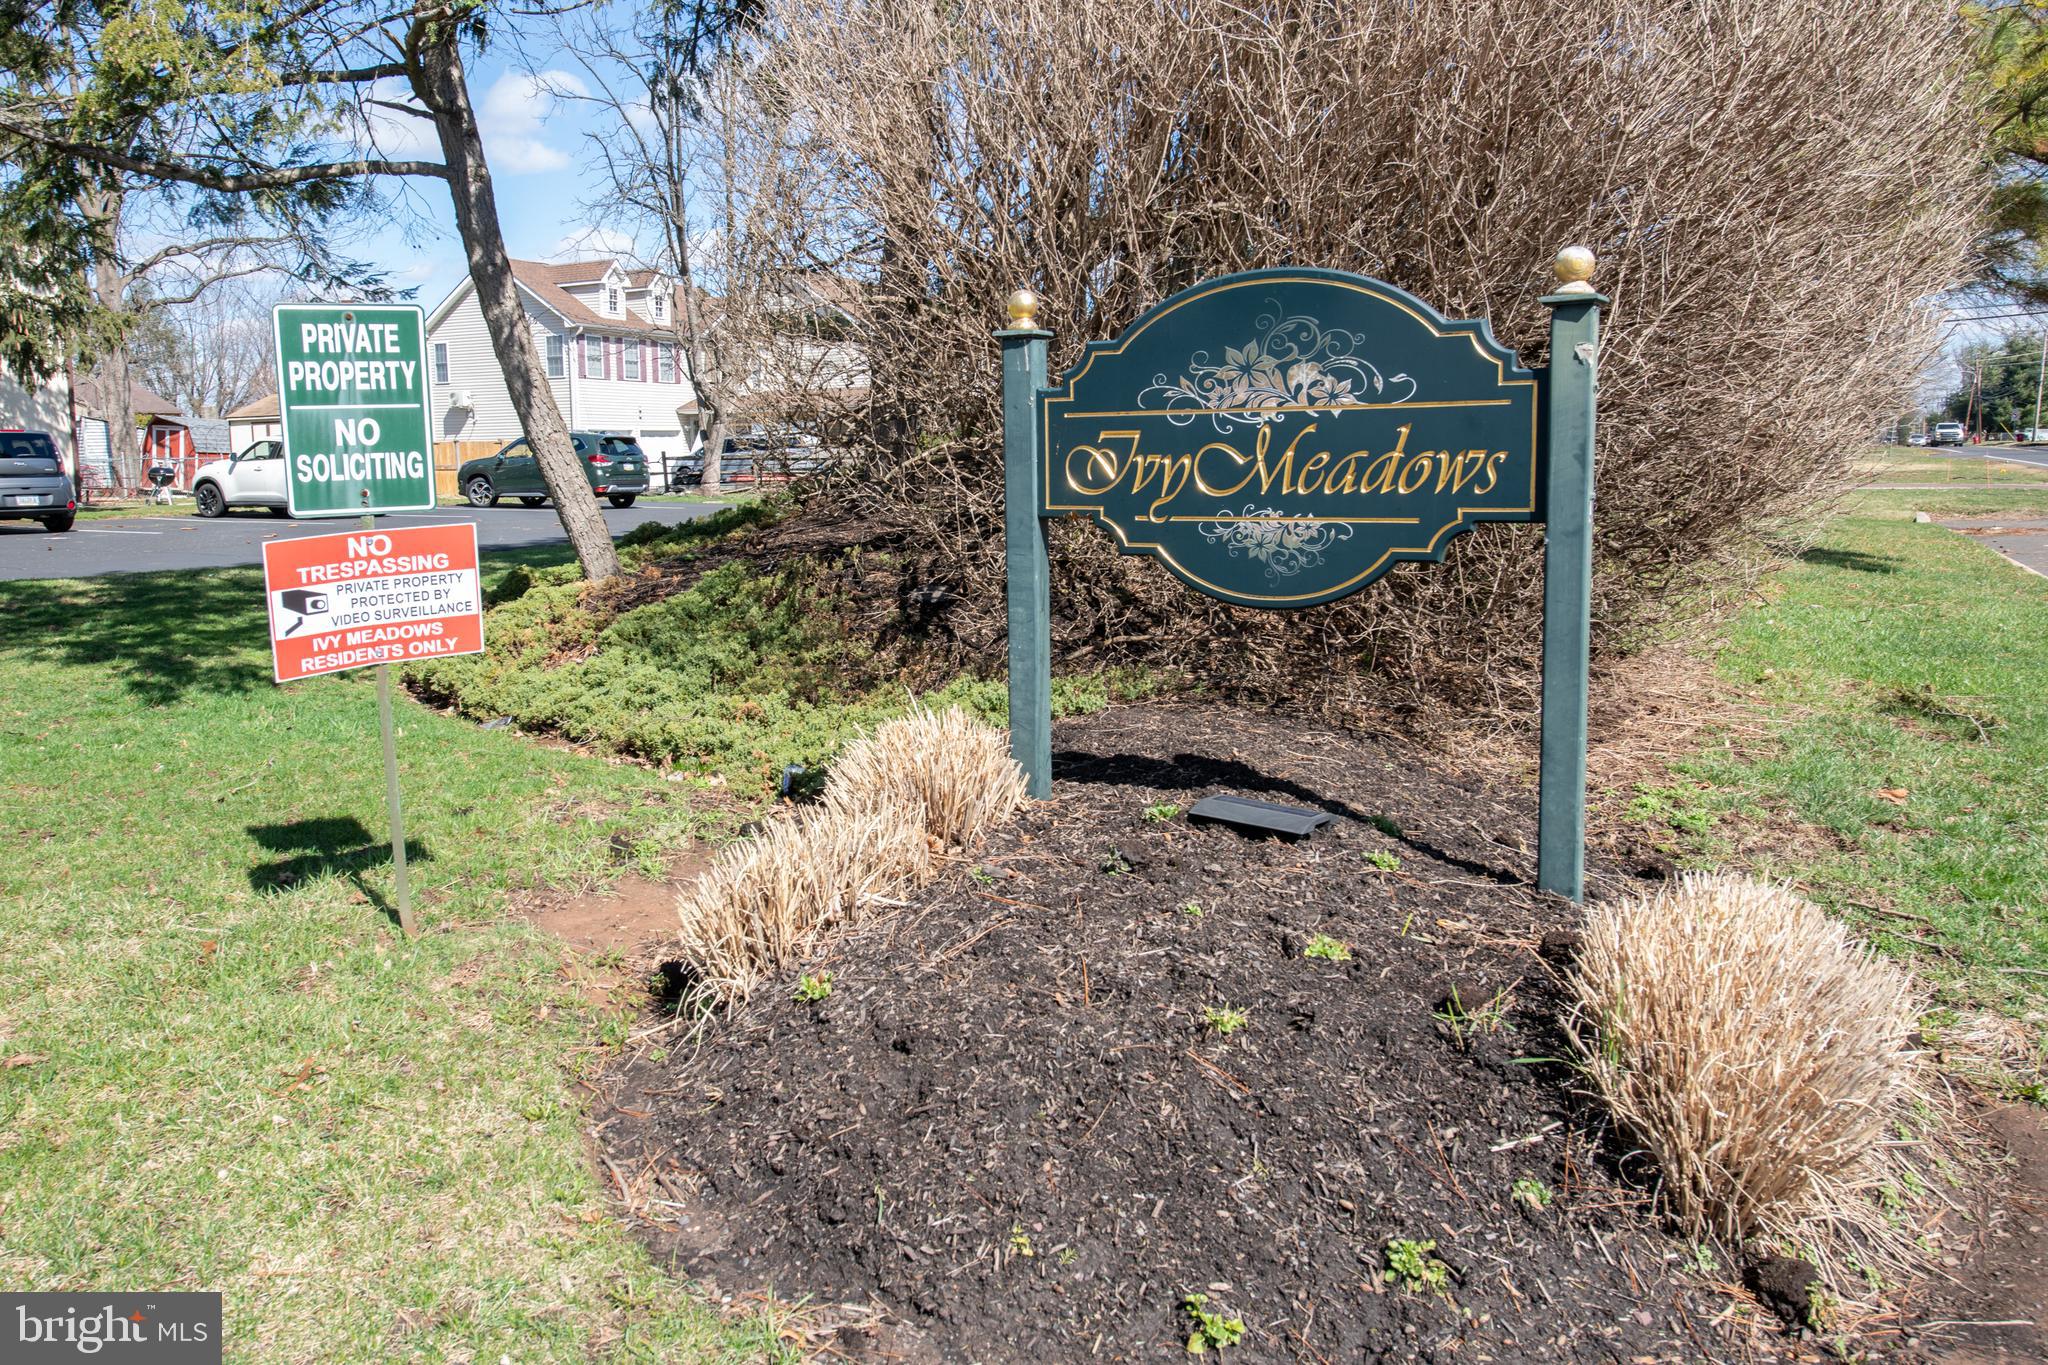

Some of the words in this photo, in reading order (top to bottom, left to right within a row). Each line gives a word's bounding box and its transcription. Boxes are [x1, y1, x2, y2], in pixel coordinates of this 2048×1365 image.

[301, 323, 400, 354] PRIVATE
[288, 360, 416, 391] PROPERTY
[334, 417, 380, 446] NO
[296, 451, 424, 483] SOLICITING
[1065, 429, 1192, 523] Ivy
[1194, 422, 1509, 497] Meadows
[347, 534, 392, 558] NO
[297, 553, 449, 584] TRESPASSING
[336, 579, 389, 596] PRIVATE
[394, 573, 463, 593] PROPERTY
[351, 591, 430, 609] PROTECTED
[434, 588, 451, 600] BY
[331, 612, 370, 627] VIDEO
[374, 601, 473, 621] SURVEILLANCE
[312, 635, 342, 652] IVY
[346, 622, 444, 646] MEADOWS
[301, 644, 404, 673] RESIDENTS
[408, 637, 459, 656] ONLY
